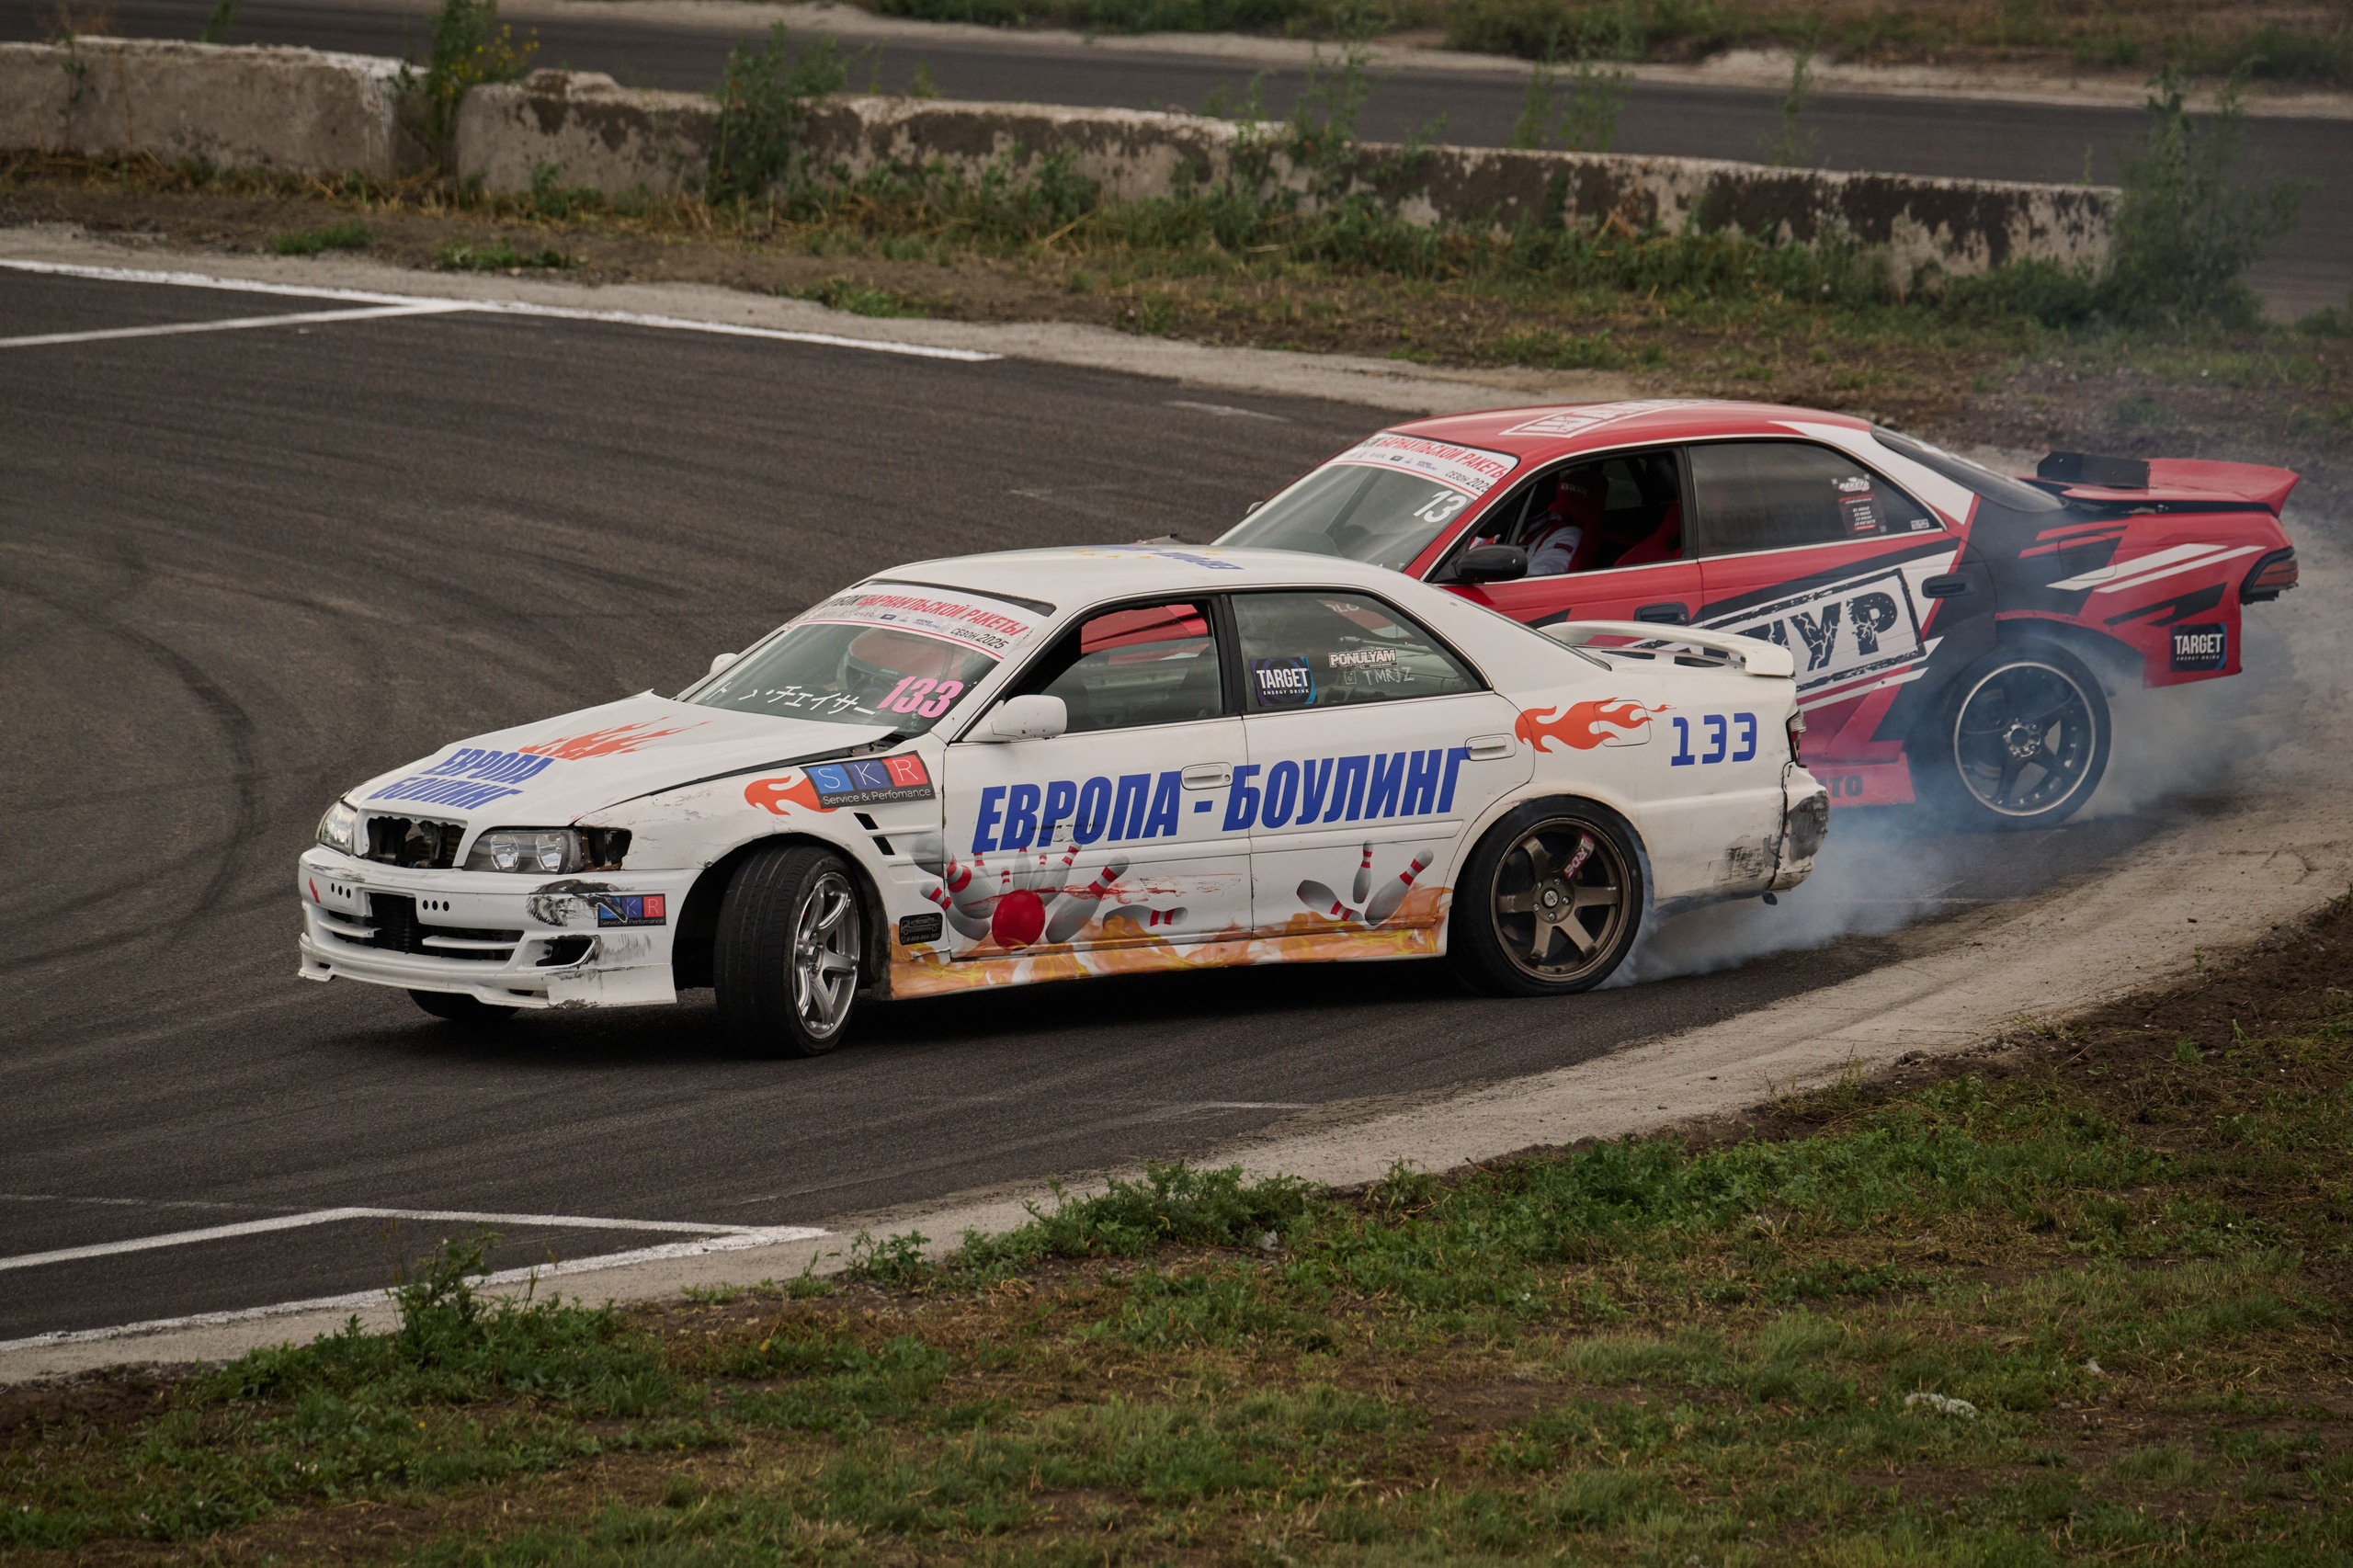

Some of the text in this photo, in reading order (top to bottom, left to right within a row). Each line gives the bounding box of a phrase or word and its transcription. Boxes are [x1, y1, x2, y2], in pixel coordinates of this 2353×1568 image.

[1413, 490, 1468, 523] 13
[857, 595, 972, 619] БАРНАУЛЬСКОЙ
[959, 608, 1029, 637] РАКЕТЫ
[950, 628, 1010, 649] СЕЗОН 2025
[2174, 633, 2223, 655] TARGET
[1329, 648, 1396, 666] PONULYAM
[1256, 667, 1309, 688] TARGET
[876, 676, 964, 718] 133
[1670, 711, 1757, 767] 133
[418, 748, 556, 785] ЕВРОПА
[817, 758, 919, 790] SKR
[368, 777, 525, 811] БОУЛИНГ
[822, 788, 932, 805] Service & Perfomance
[971, 770, 1182, 853] ЕВРОПА
[1222, 746, 1473, 832] БОУЛИНГ
